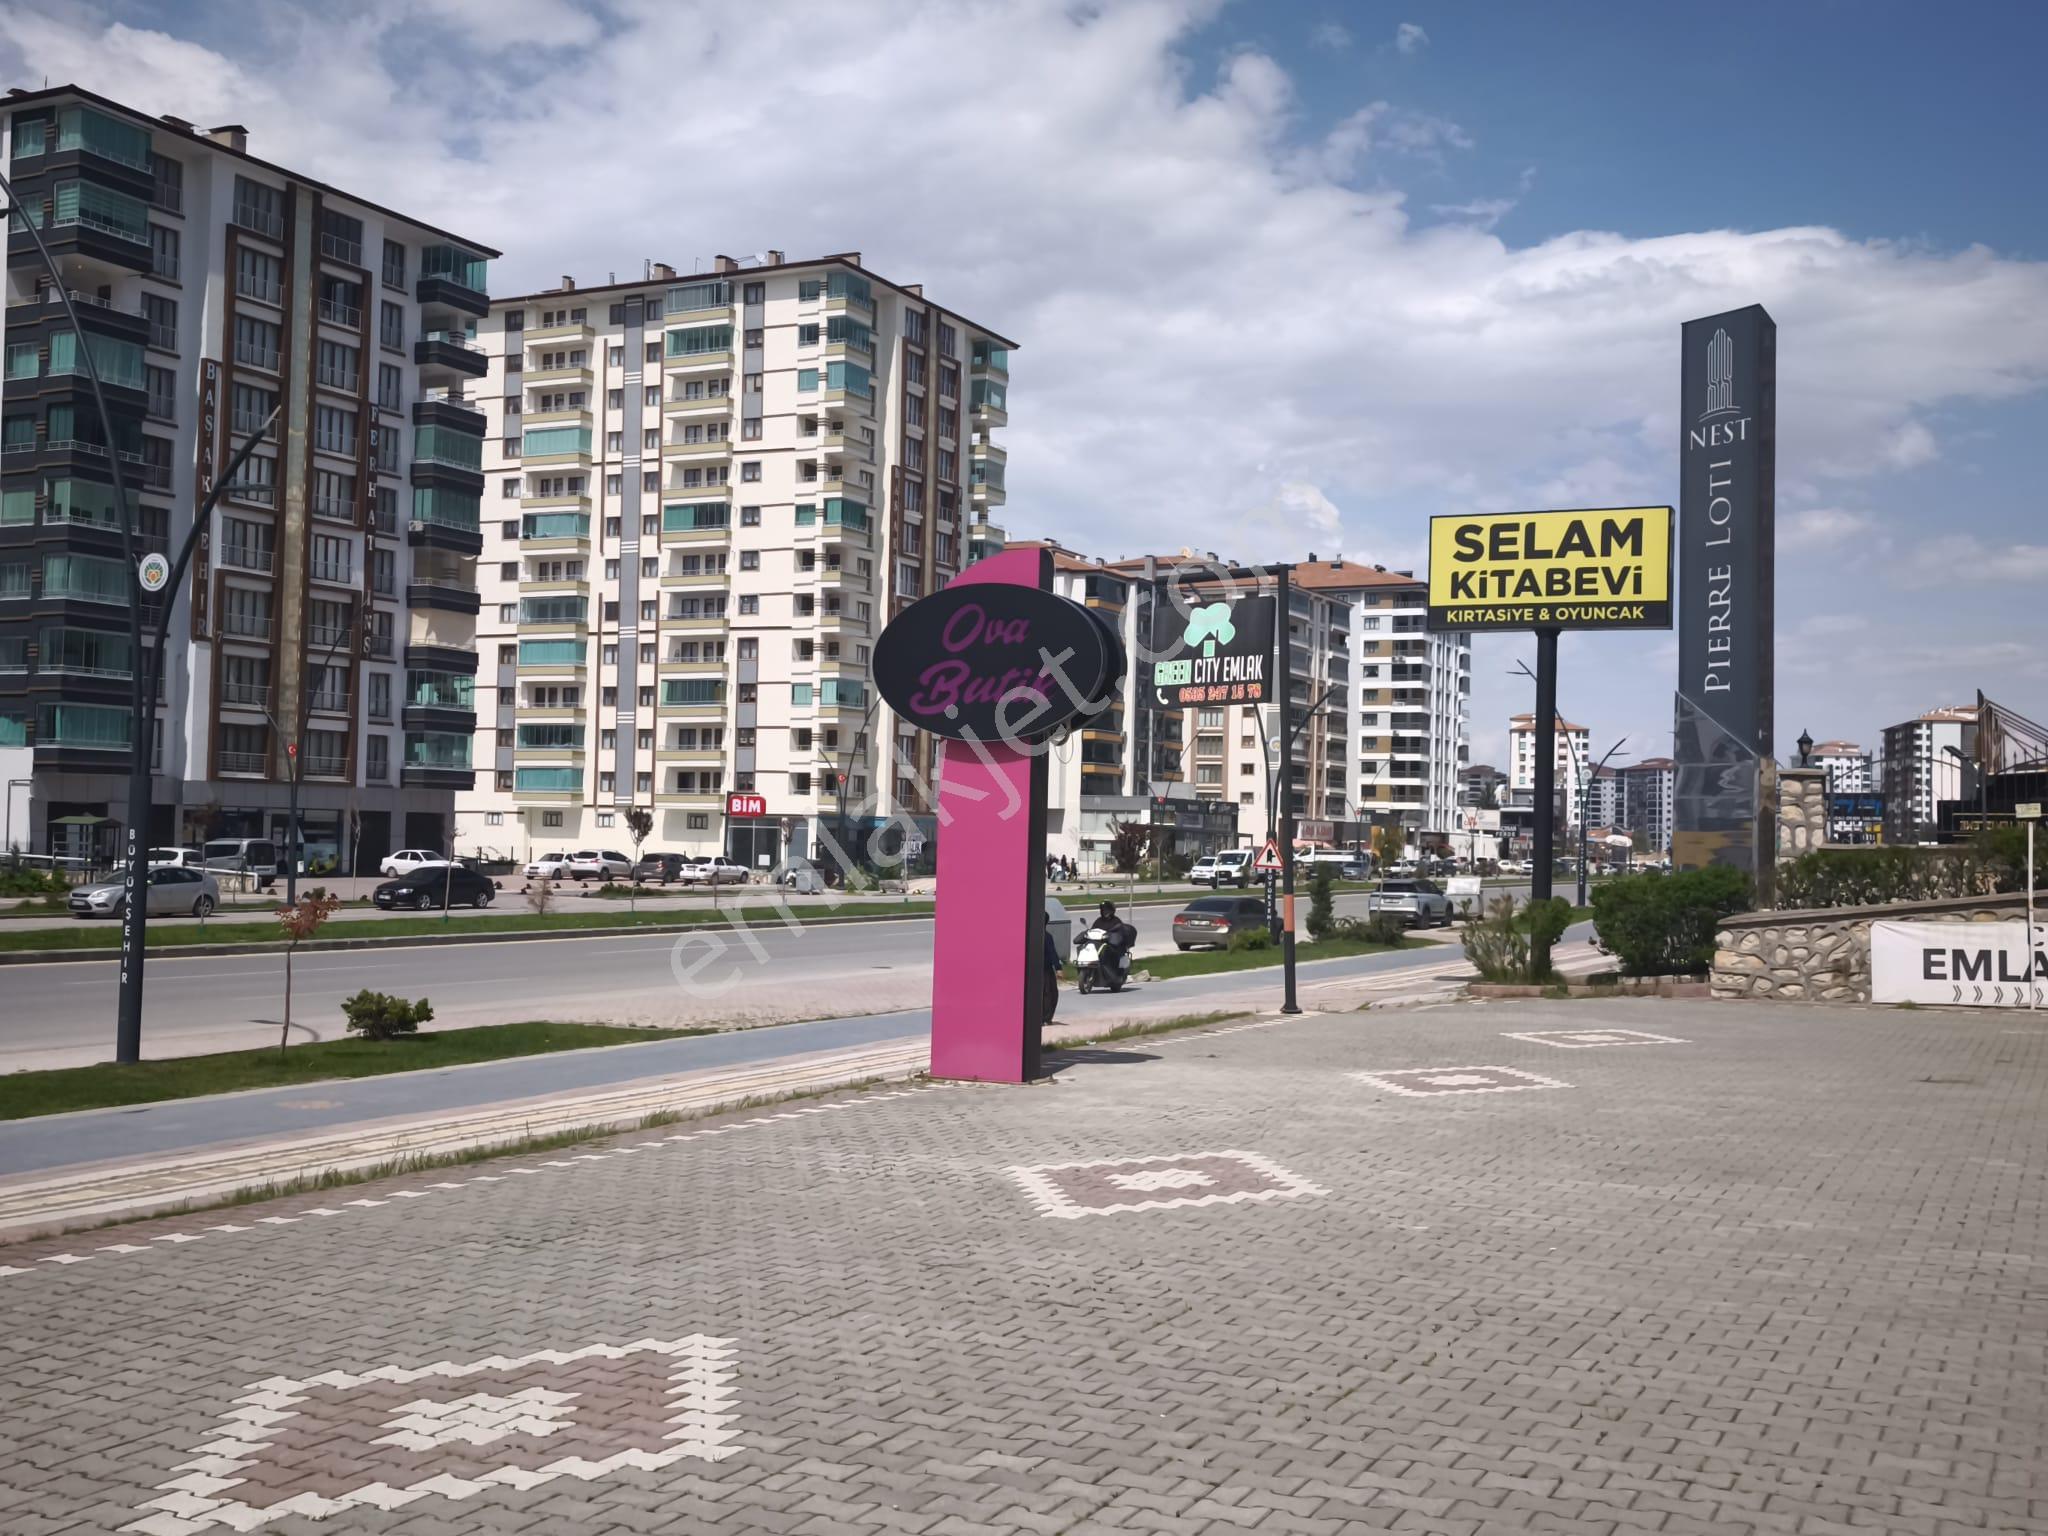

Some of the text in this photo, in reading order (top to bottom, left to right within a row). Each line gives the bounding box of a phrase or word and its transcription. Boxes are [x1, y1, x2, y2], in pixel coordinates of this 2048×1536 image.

[1690, 418, 1751, 450] NEST
[366, 406, 379, 551] FERHAT
[1453, 518, 1644, 562] SELAM
[1704, 460, 1732, 694] PIERRE LOTI
[942, 603, 1030, 652] Ova
[1539, 607, 1550, 620] &
[1555, 606, 1645, 620] OYUNCAK
[910, 659, 1056, 715] Butik
[1194, 657, 1221, 683] CITY
[1223, 655, 1263, 682] EMLAK
[731, 796, 761, 813] BİM
